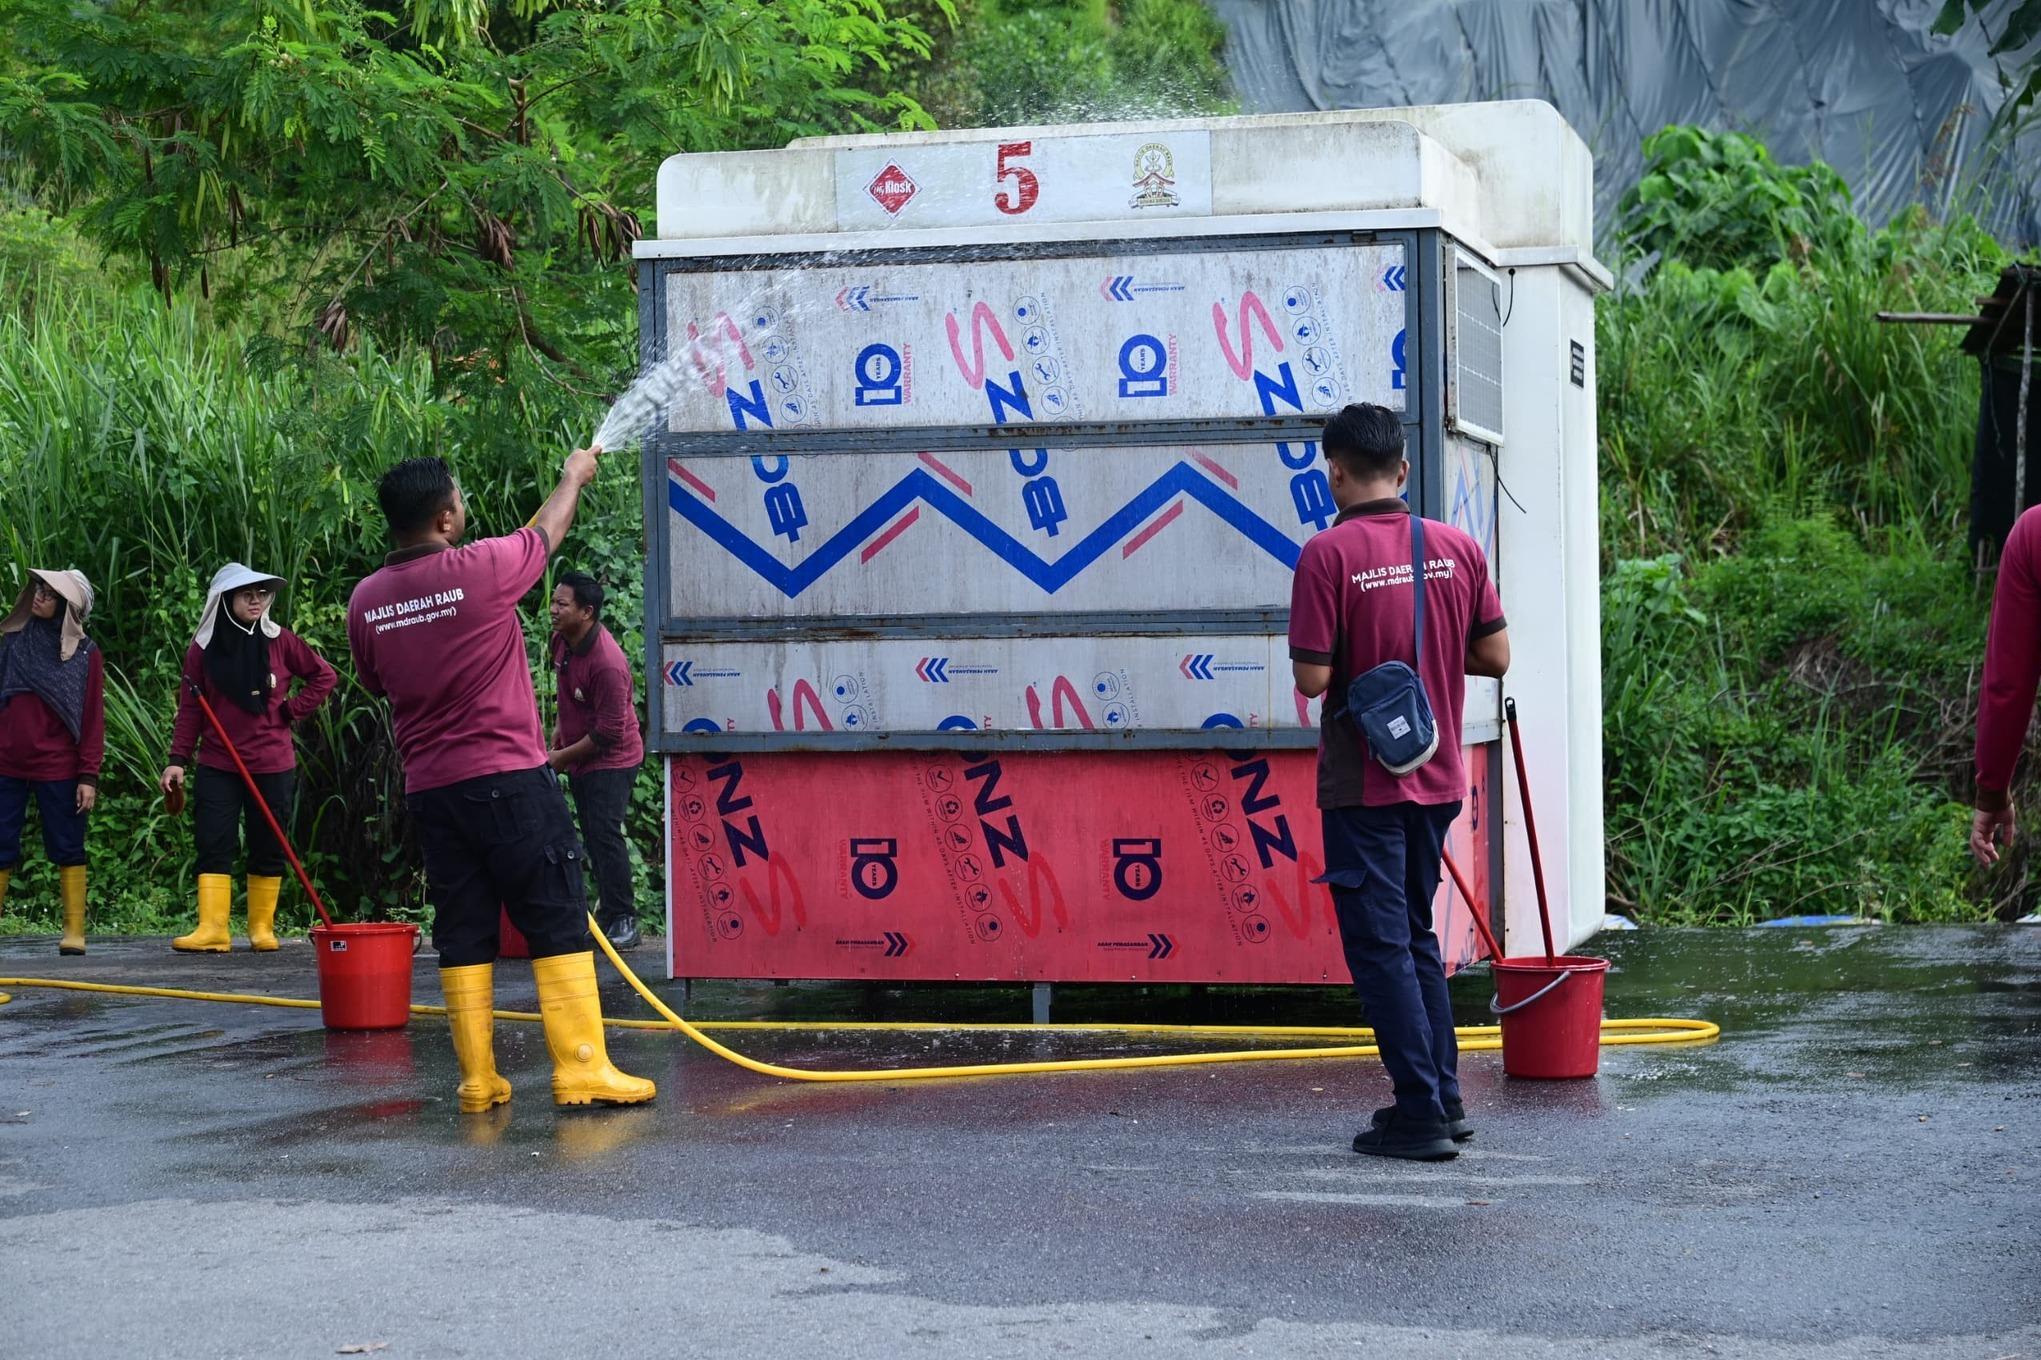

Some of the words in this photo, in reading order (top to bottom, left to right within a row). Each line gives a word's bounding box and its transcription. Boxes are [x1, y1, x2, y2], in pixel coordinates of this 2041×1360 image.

[885, 180, 911, 194] Kiosk
[994, 141, 1040, 215] 5
[855, 343, 902, 406] 10
[903, 343, 912, 404] WARRANTY
[1118, 334, 1167, 397] 10
[1168, 333, 1177, 396] WARRANTY
[1352, 567, 1387, 584] MAJLIS
[1388, 561, 1426, 575] DAER
[364, 605, 395, 624] MAJLIS
[396, 595, 434, 614] DAERAH
[435, 588, 464, 605] RAUB
[375, 606, 457, 635] (www.mdraub.gov.my)
[851, 838, 898, 900] 10
[1113, 839, 1162, 901] 10
